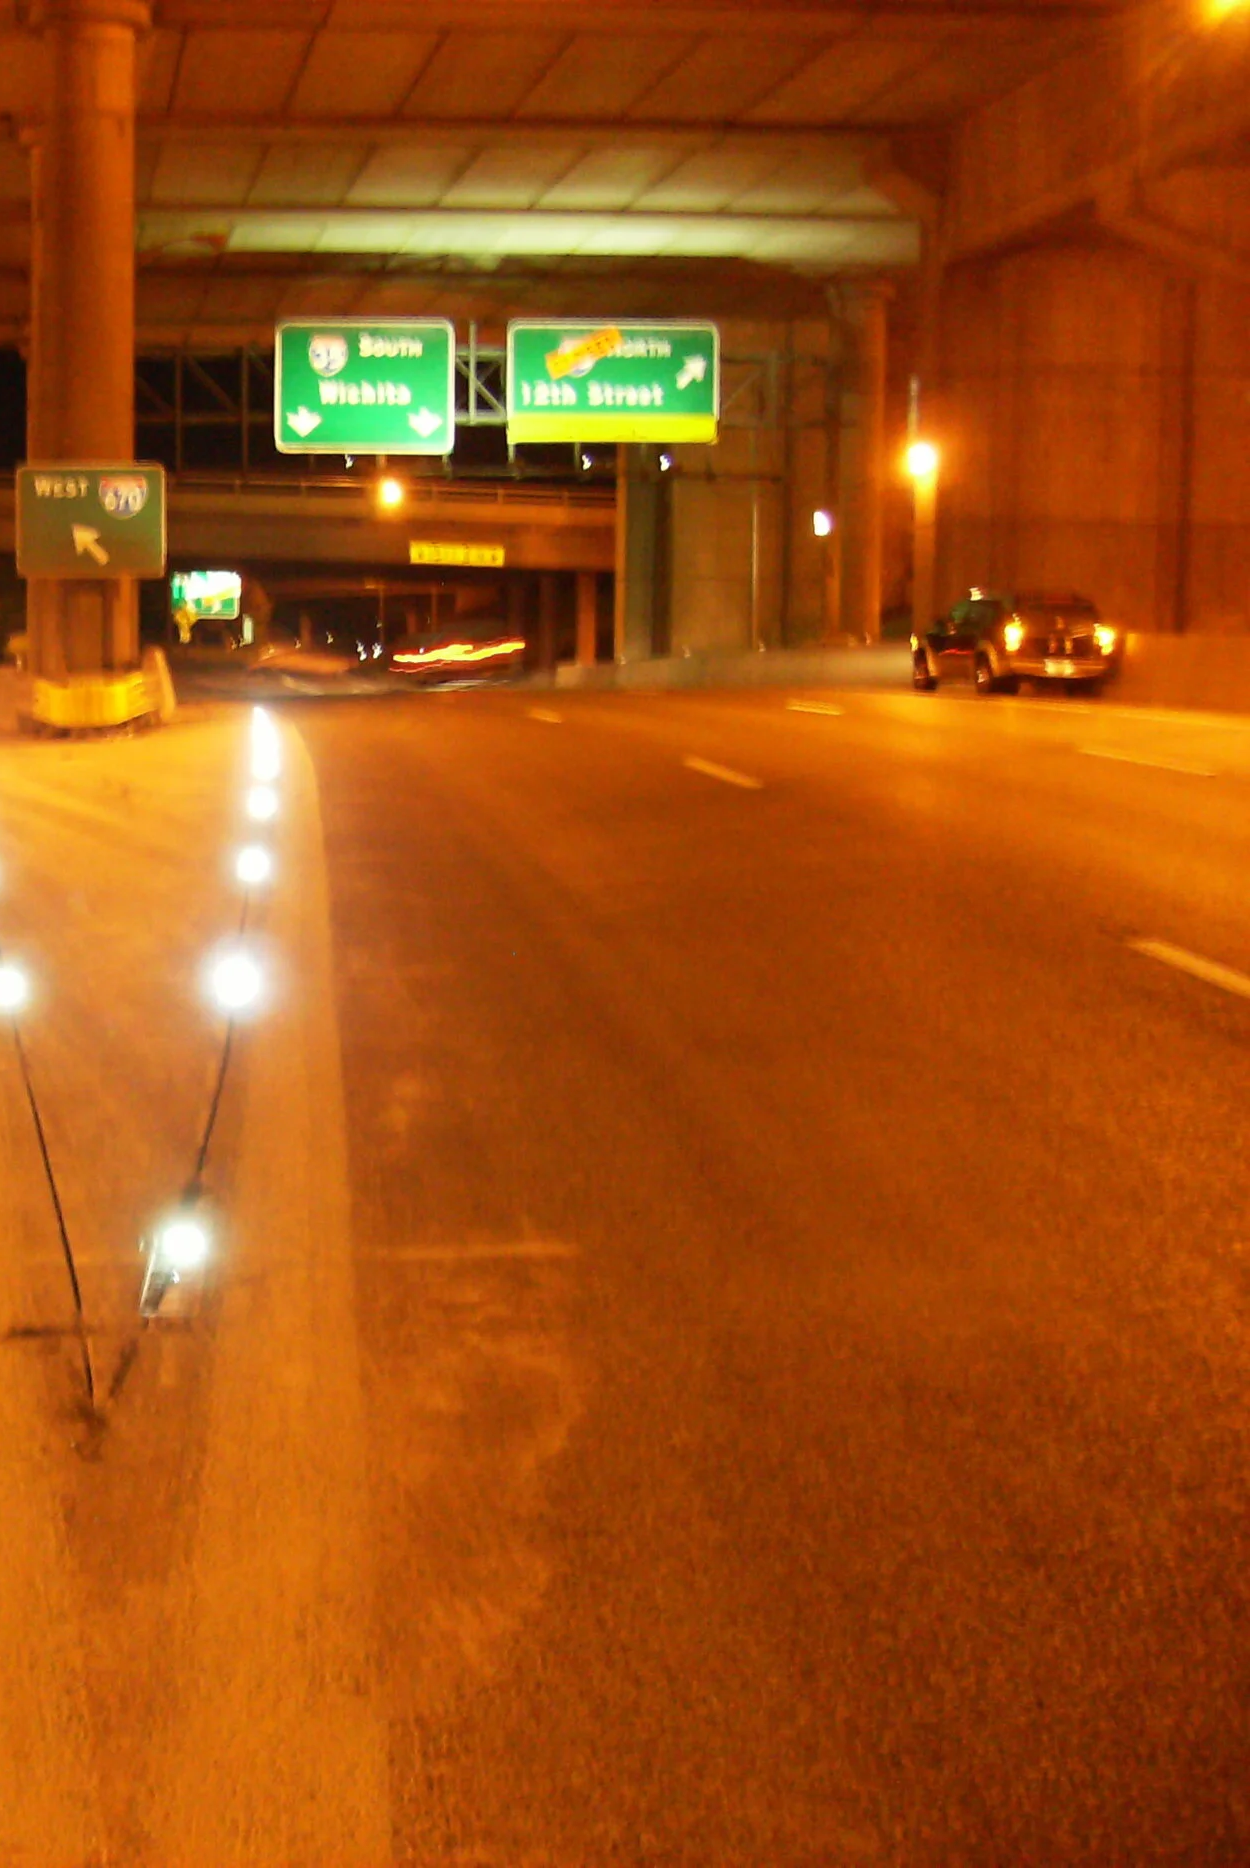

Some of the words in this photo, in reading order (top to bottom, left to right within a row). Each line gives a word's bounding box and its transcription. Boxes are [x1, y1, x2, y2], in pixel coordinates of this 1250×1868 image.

[358, 332, 423, 359] SOUTH
[318, 380, 411, 405] Wichita
[520, 380, 577, 406] 12th
[587, 381, 664, 407] Street
[34, 477, 88, 498] WEST
